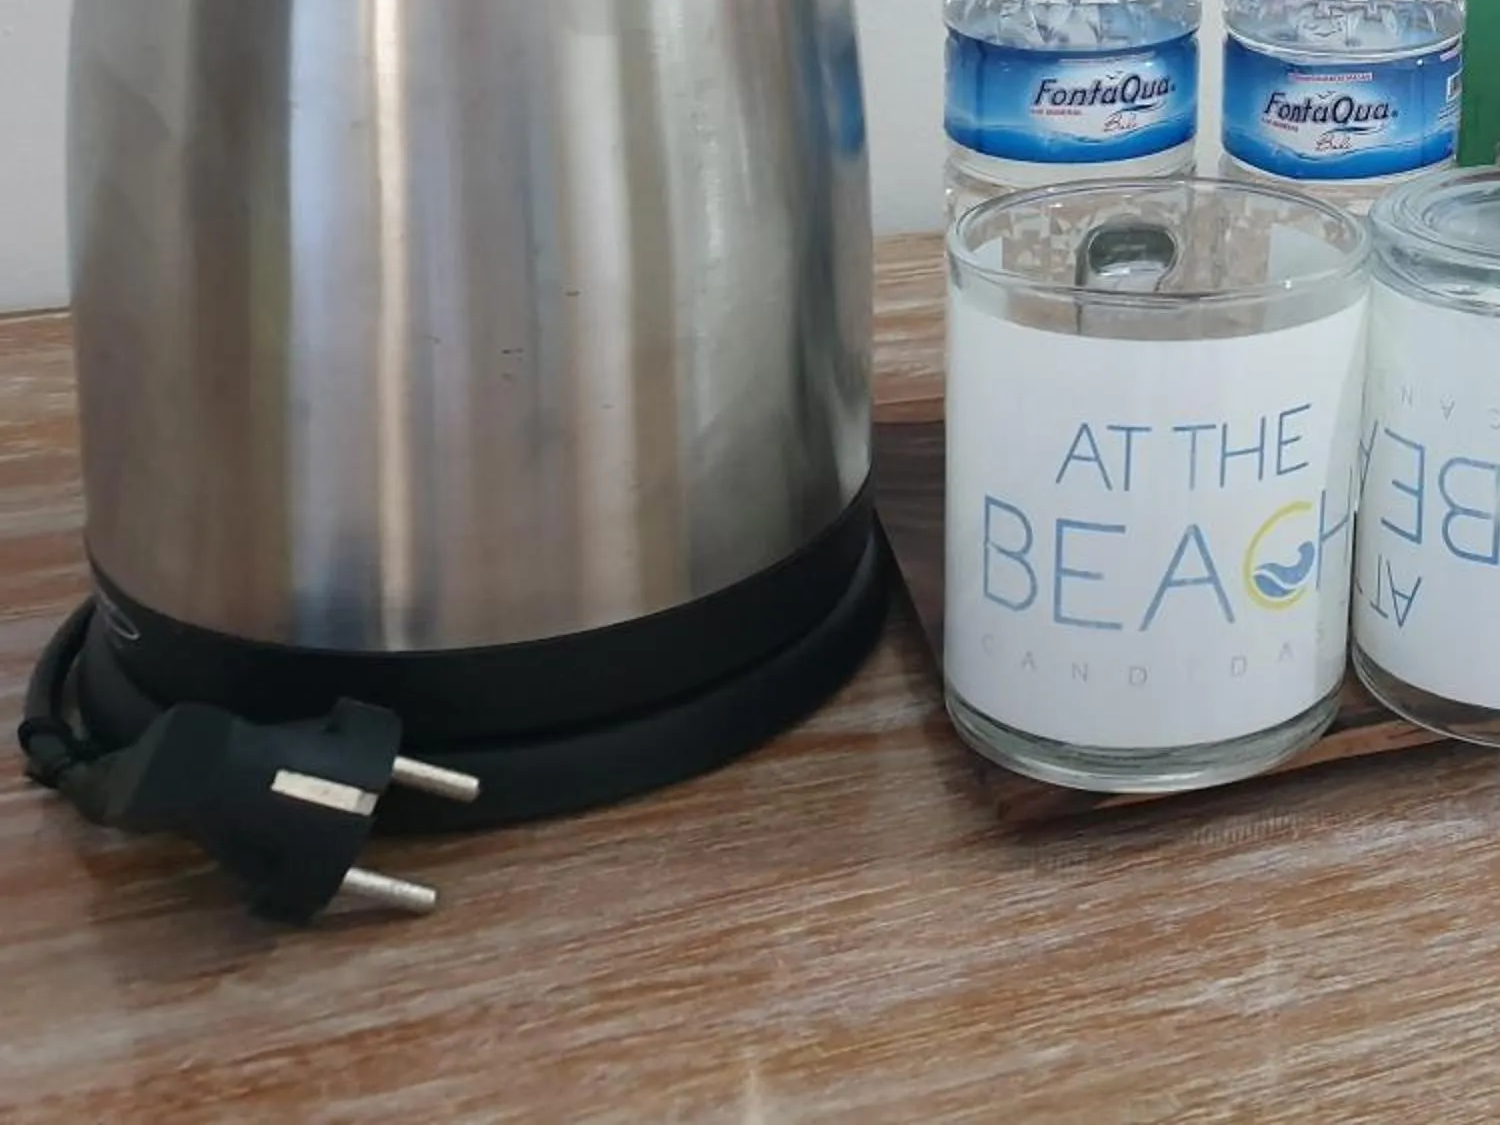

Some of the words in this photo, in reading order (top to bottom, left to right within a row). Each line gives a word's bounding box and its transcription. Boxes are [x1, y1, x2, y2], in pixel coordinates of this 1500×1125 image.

[1034, 72, 1172, 107] FontaQua
[1263, 91, 1391, 125] FontaQua
[1056, 421, 1153, 492] AT
[1173, 403, 1312, 491] THE
